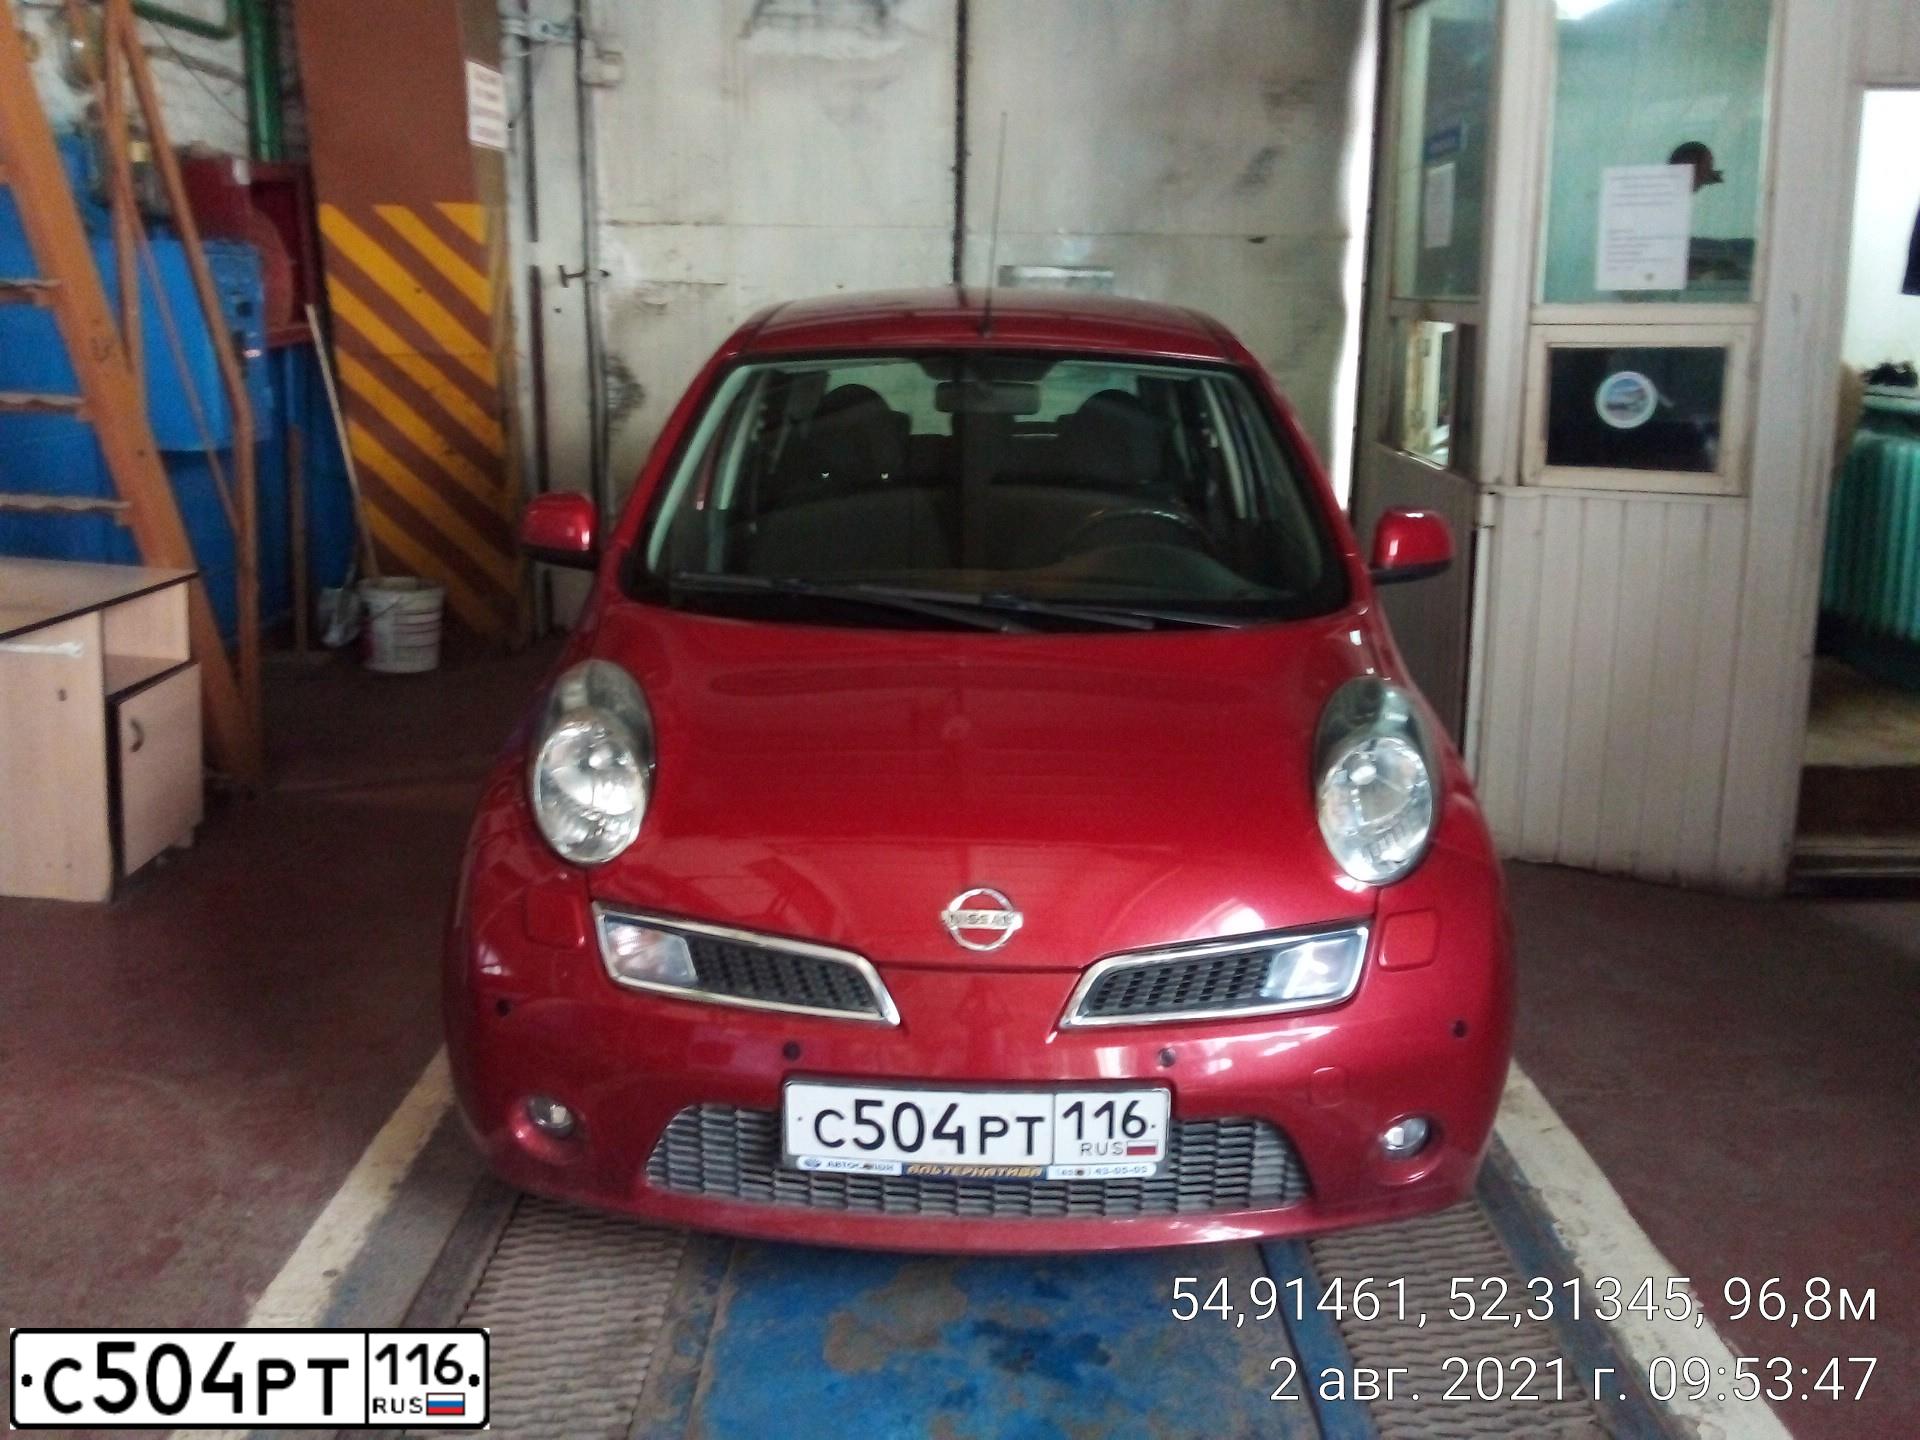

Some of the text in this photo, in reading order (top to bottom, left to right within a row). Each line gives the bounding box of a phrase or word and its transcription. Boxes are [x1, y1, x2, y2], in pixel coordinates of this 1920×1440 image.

[814, 1099, 1045, 1155] С504РТ
[1062, 1100, 1146, 1140] 116
[1081, 1141, 1124, 1156] RUS
